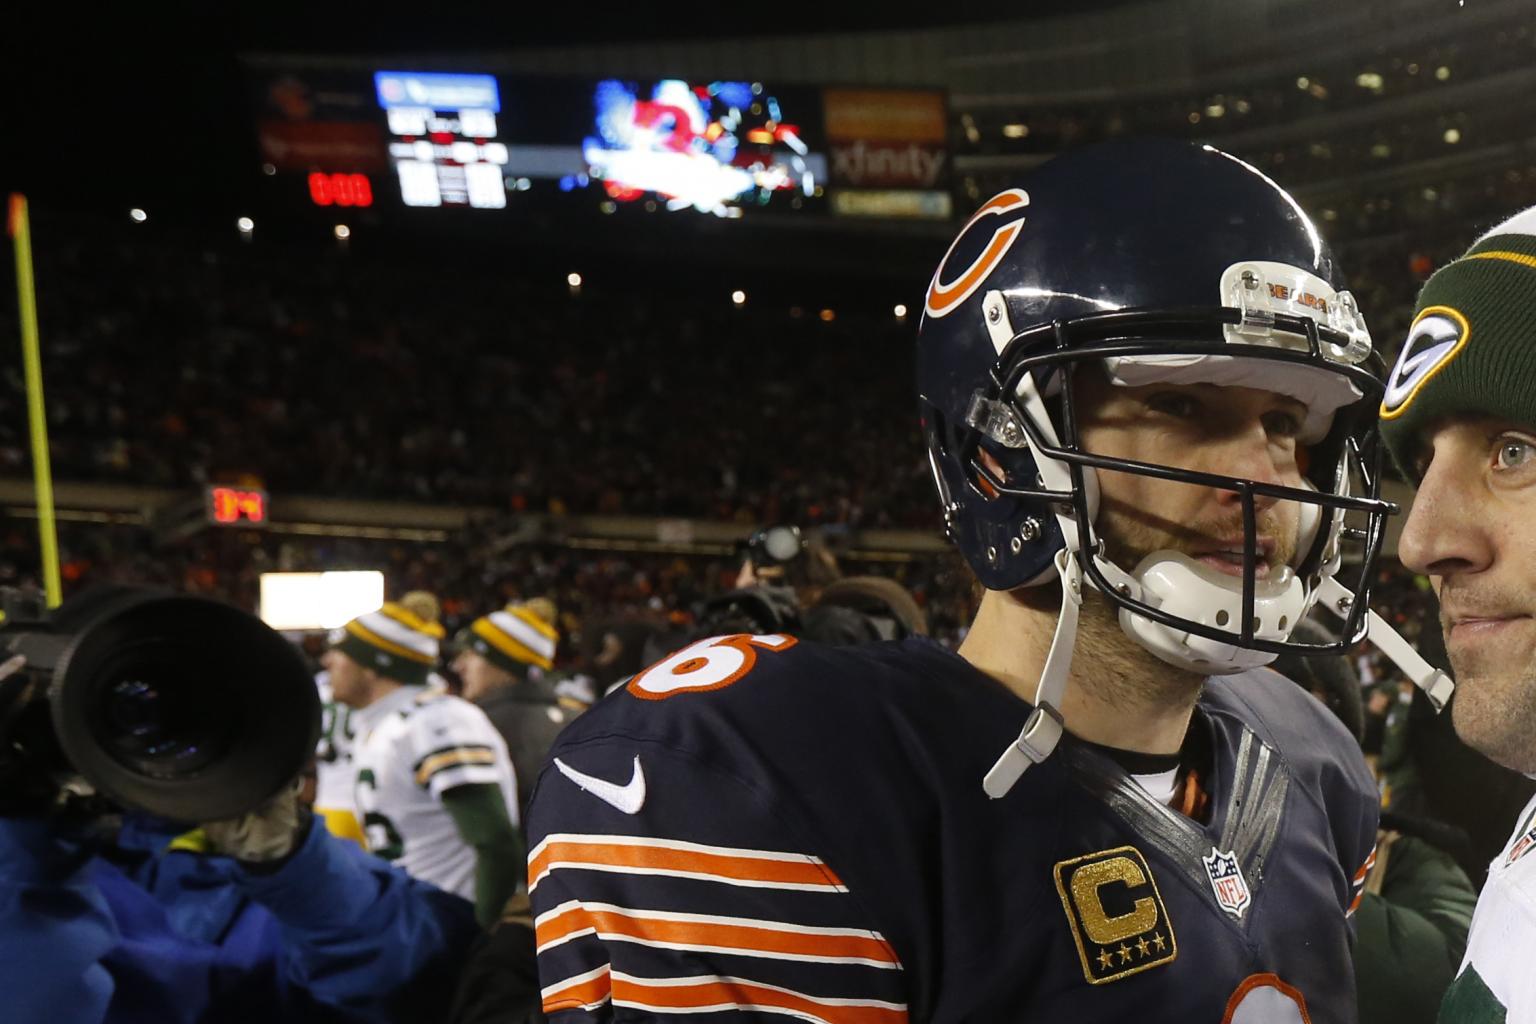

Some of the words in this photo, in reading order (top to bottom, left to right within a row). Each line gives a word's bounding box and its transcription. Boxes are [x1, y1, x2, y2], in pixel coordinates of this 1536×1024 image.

[626, 633, 798, 700] 6
[1070, 856, 1158, 945] C
[1215, 877, 1245, 905] NFL
